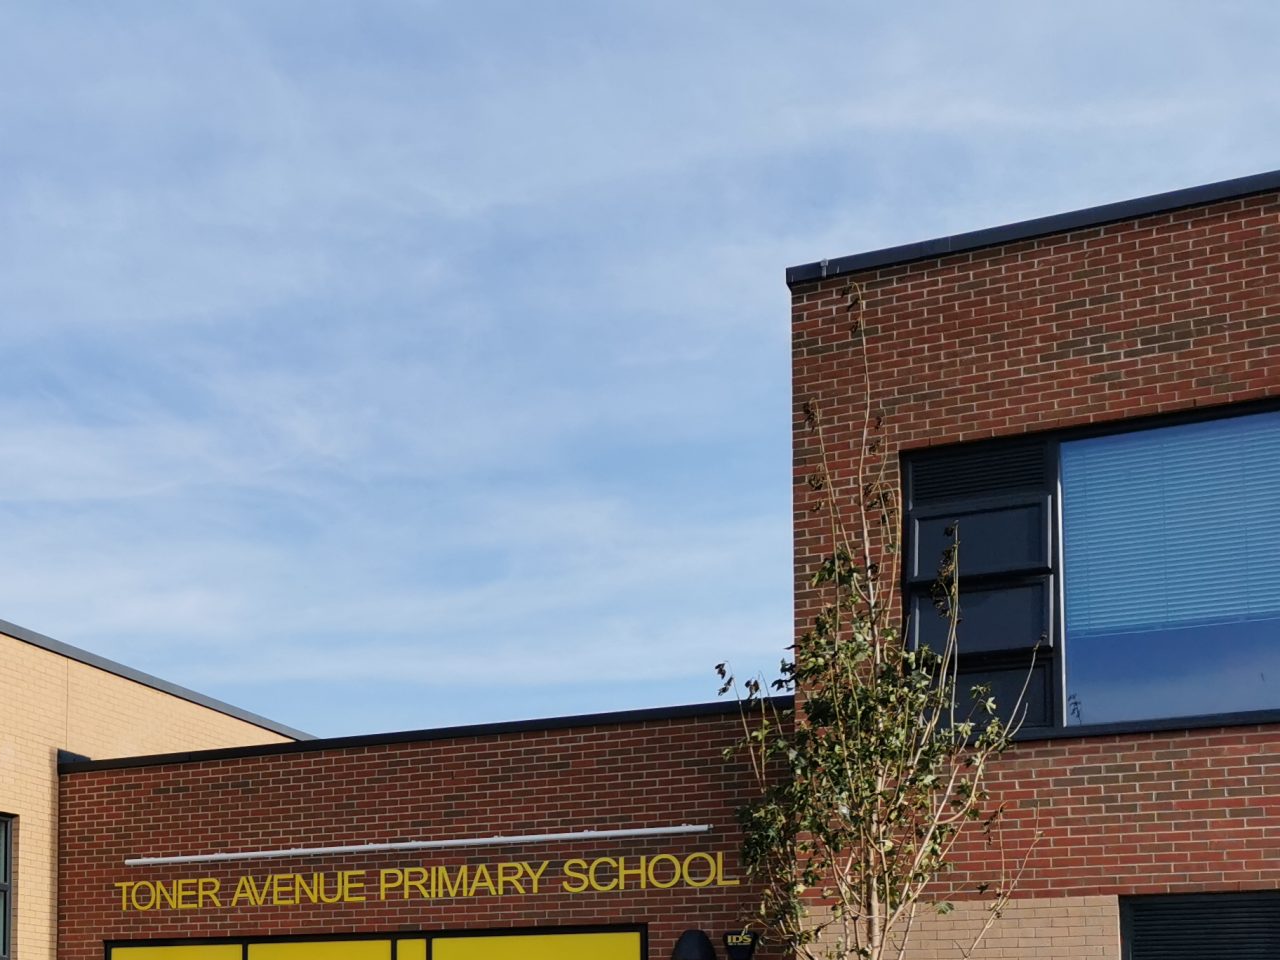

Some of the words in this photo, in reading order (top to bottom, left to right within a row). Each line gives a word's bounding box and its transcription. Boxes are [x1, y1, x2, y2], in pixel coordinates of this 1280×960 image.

[114, 876, 222, 911] TONER
[231, 869, 367, 907] AVENUE
[379, 860, 550, 901] PRIMARY
[562, 851, 740, 894] SCHOOL
[727, 934, 753, 943] IDS
